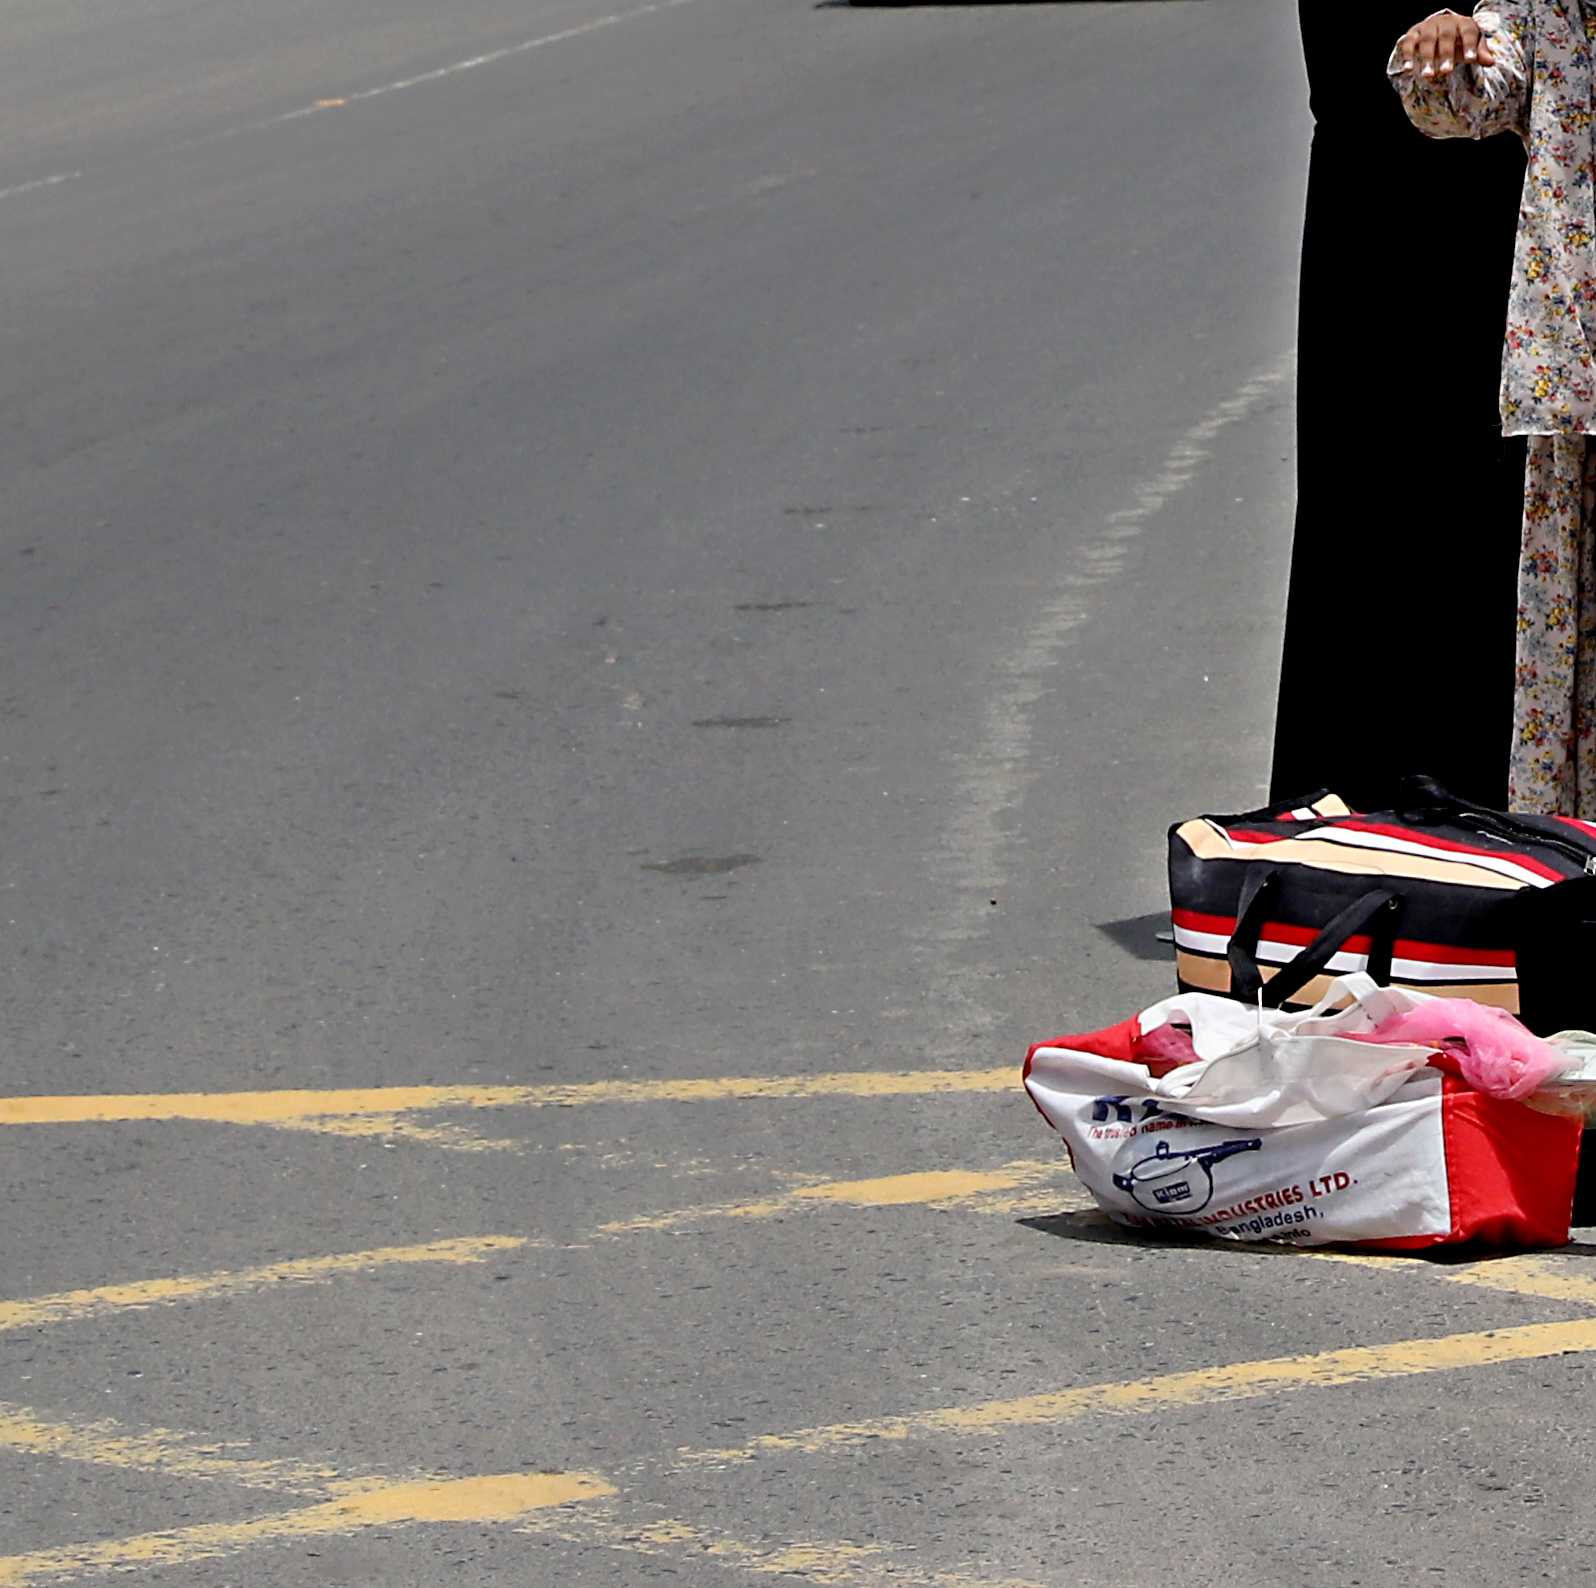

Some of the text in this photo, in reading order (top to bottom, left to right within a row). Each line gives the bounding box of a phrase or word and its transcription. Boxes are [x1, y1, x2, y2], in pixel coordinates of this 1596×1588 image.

[1088, 1126, 1104, 1139] The
[1141, 1121, 1173, 1134] name
[1309, 1171, 1358, 1199] LTD.
